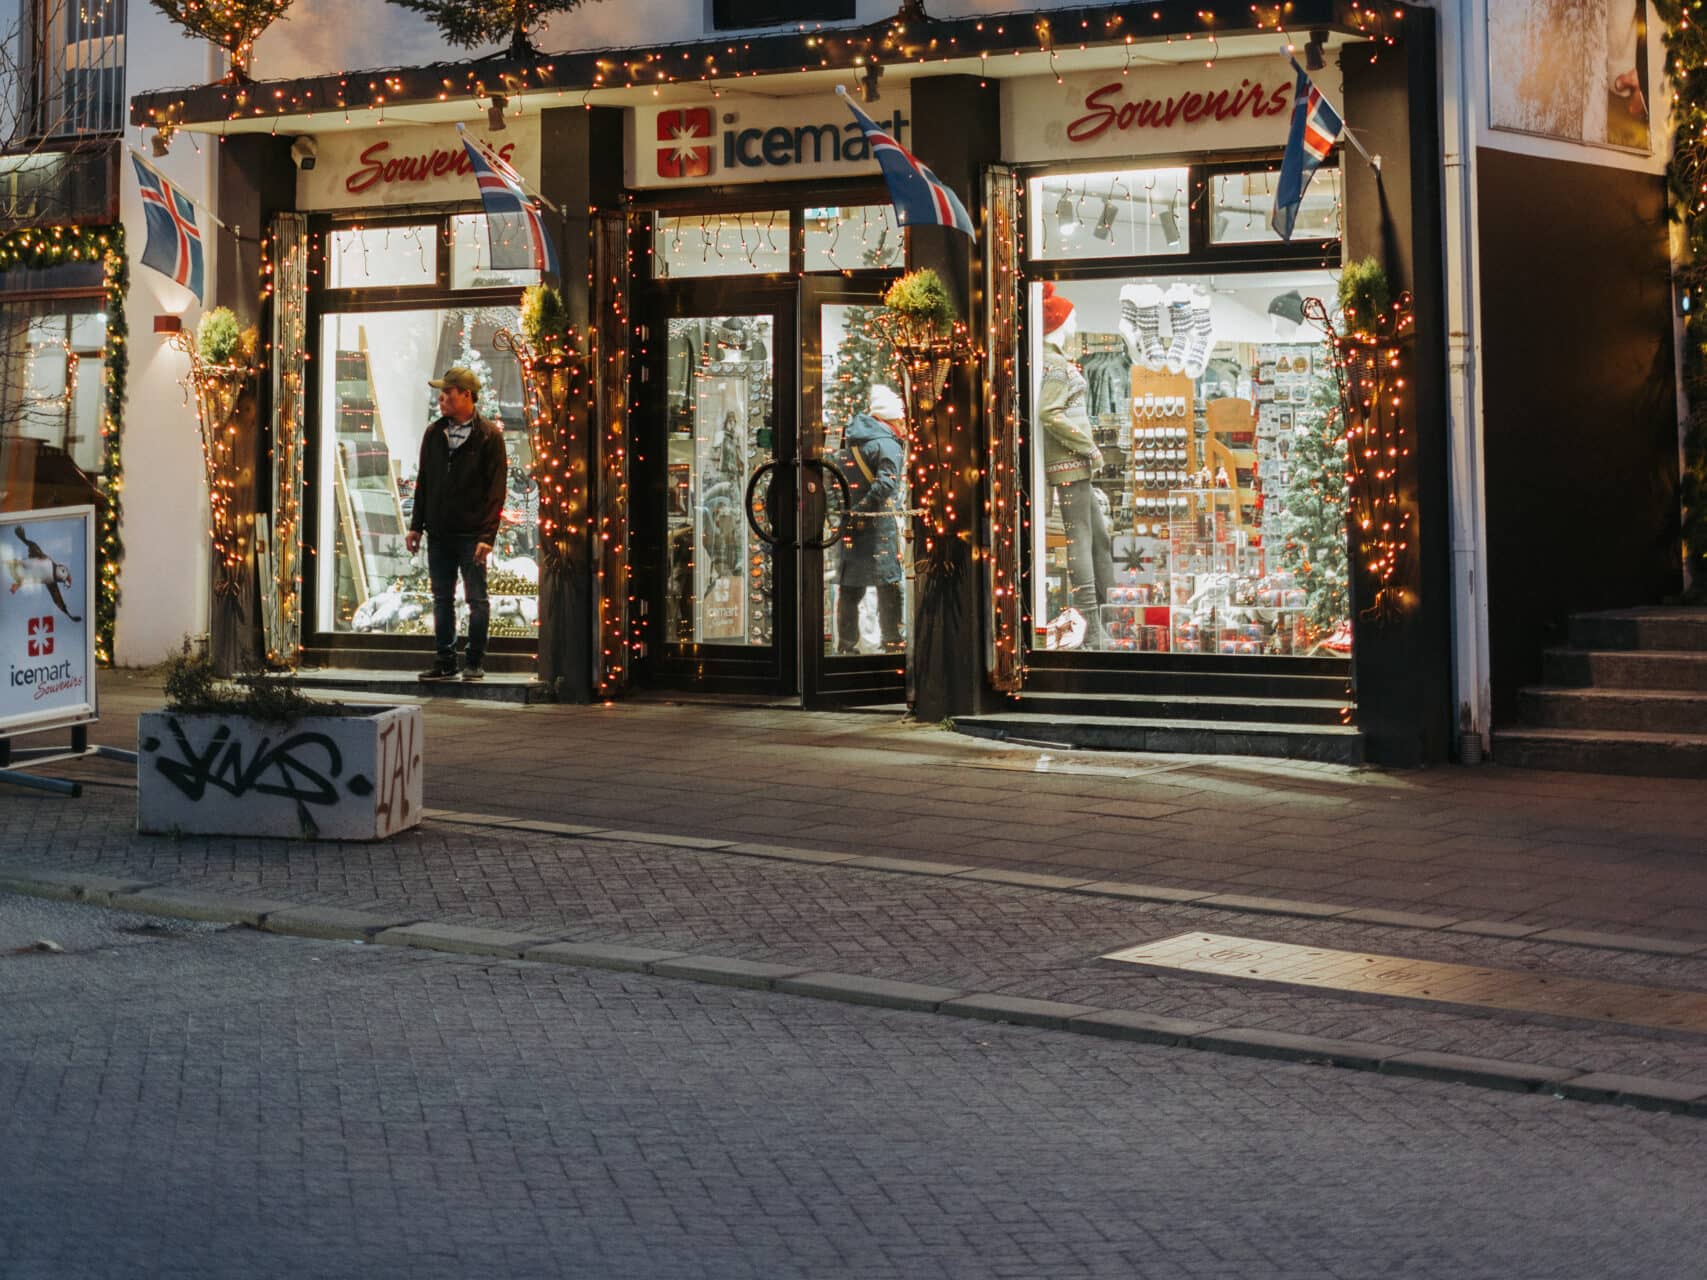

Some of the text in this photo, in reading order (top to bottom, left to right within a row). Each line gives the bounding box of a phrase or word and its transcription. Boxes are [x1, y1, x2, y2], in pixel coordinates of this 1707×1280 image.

[1066, 78, 1293, 142] Souvenirs
[345, 138, 516, 193] Souvens
[10, 659, 71, 687] icemart
